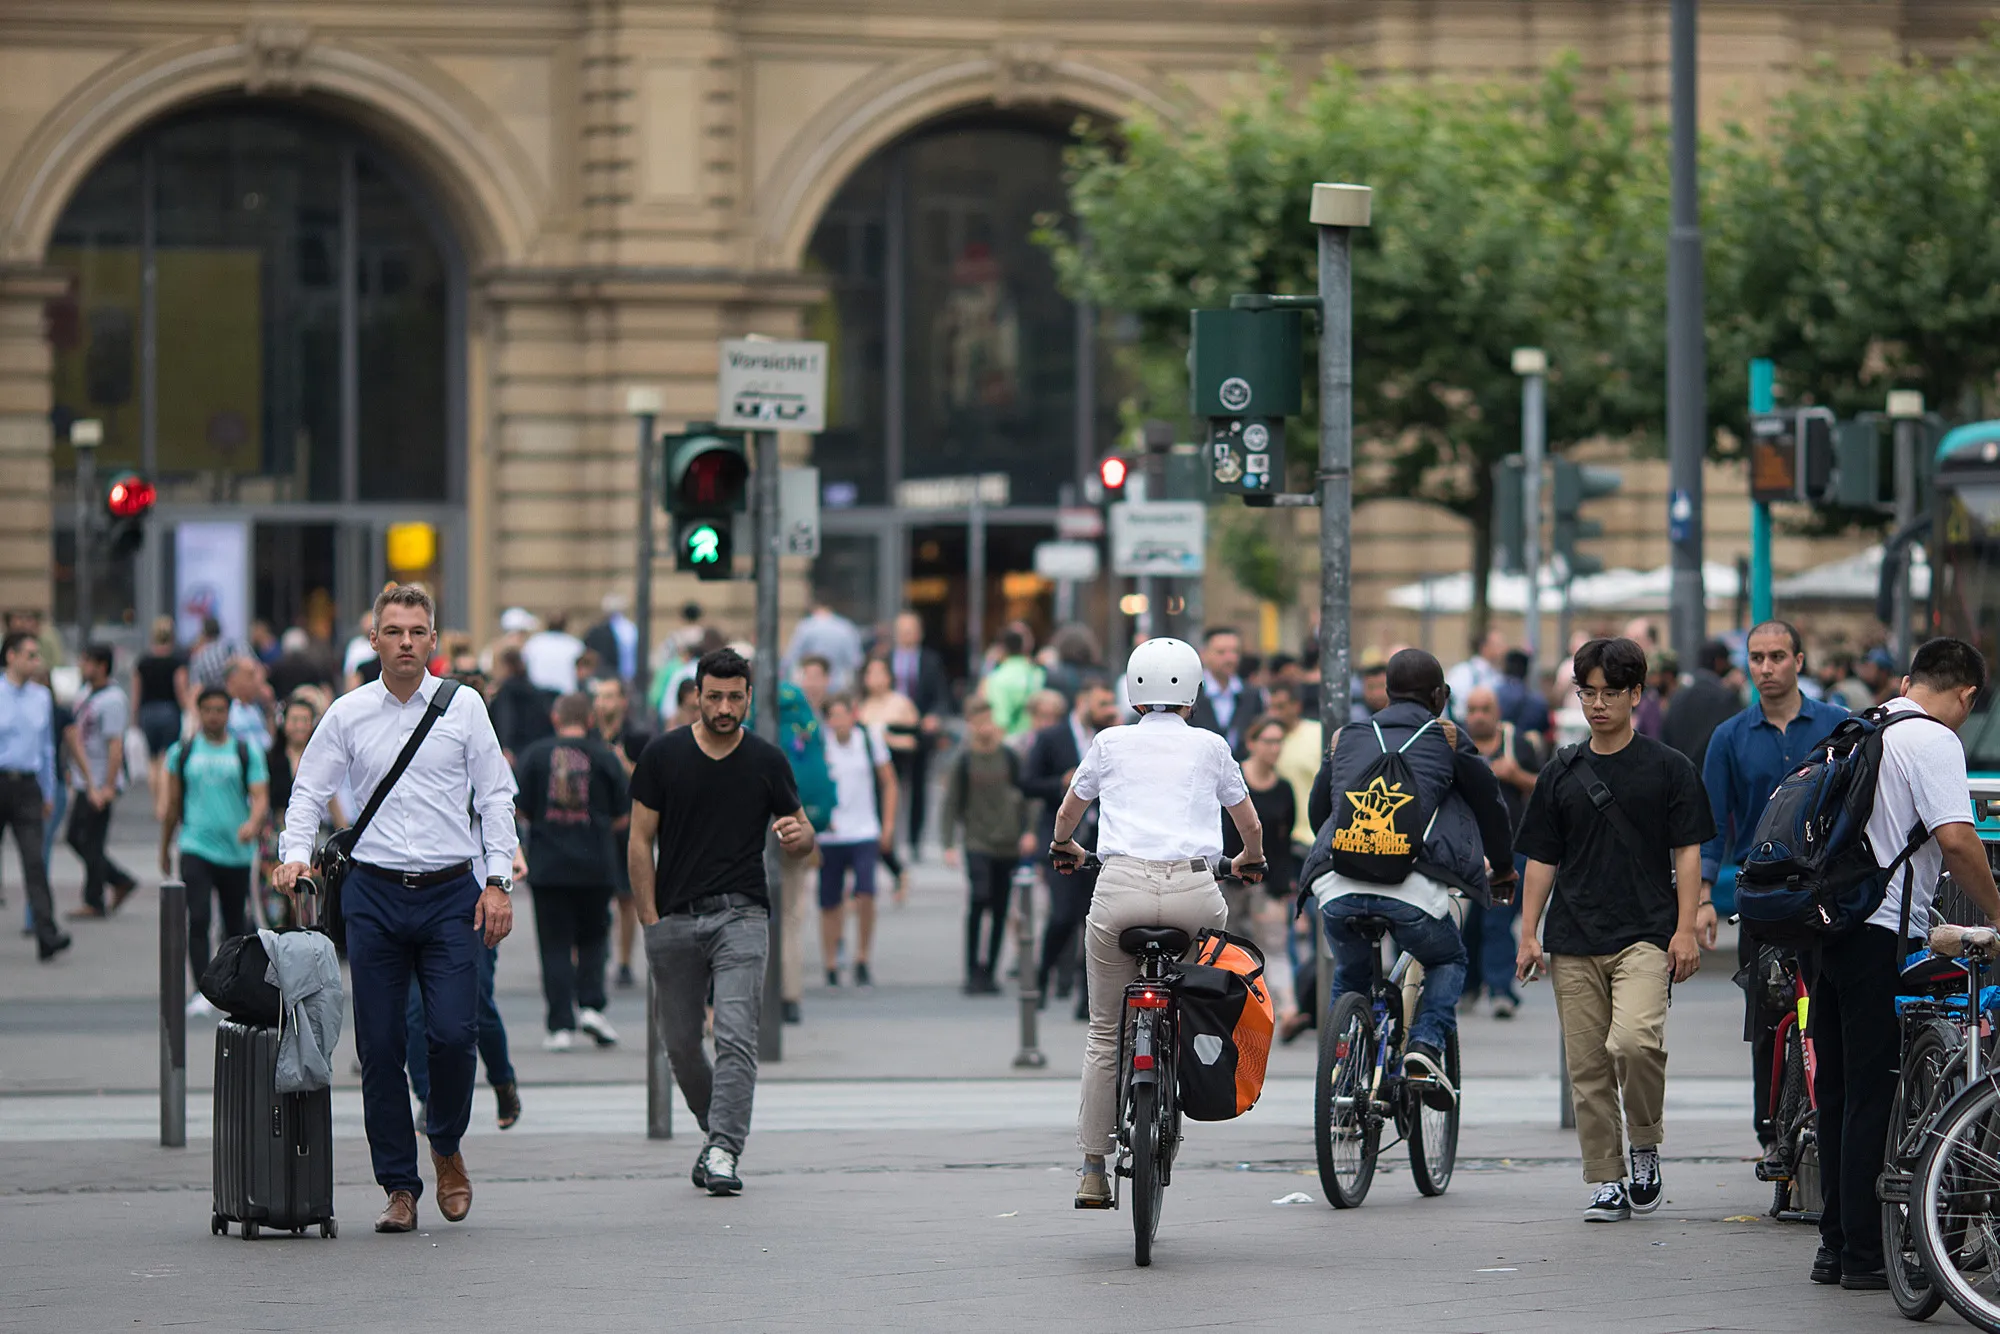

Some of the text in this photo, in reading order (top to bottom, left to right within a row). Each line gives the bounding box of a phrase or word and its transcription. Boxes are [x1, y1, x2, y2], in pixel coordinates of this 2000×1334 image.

[1335, 828, 1408, 844] GOOD NIGHT
[1332, 837, 1411, 855] WHITE PRIDE
